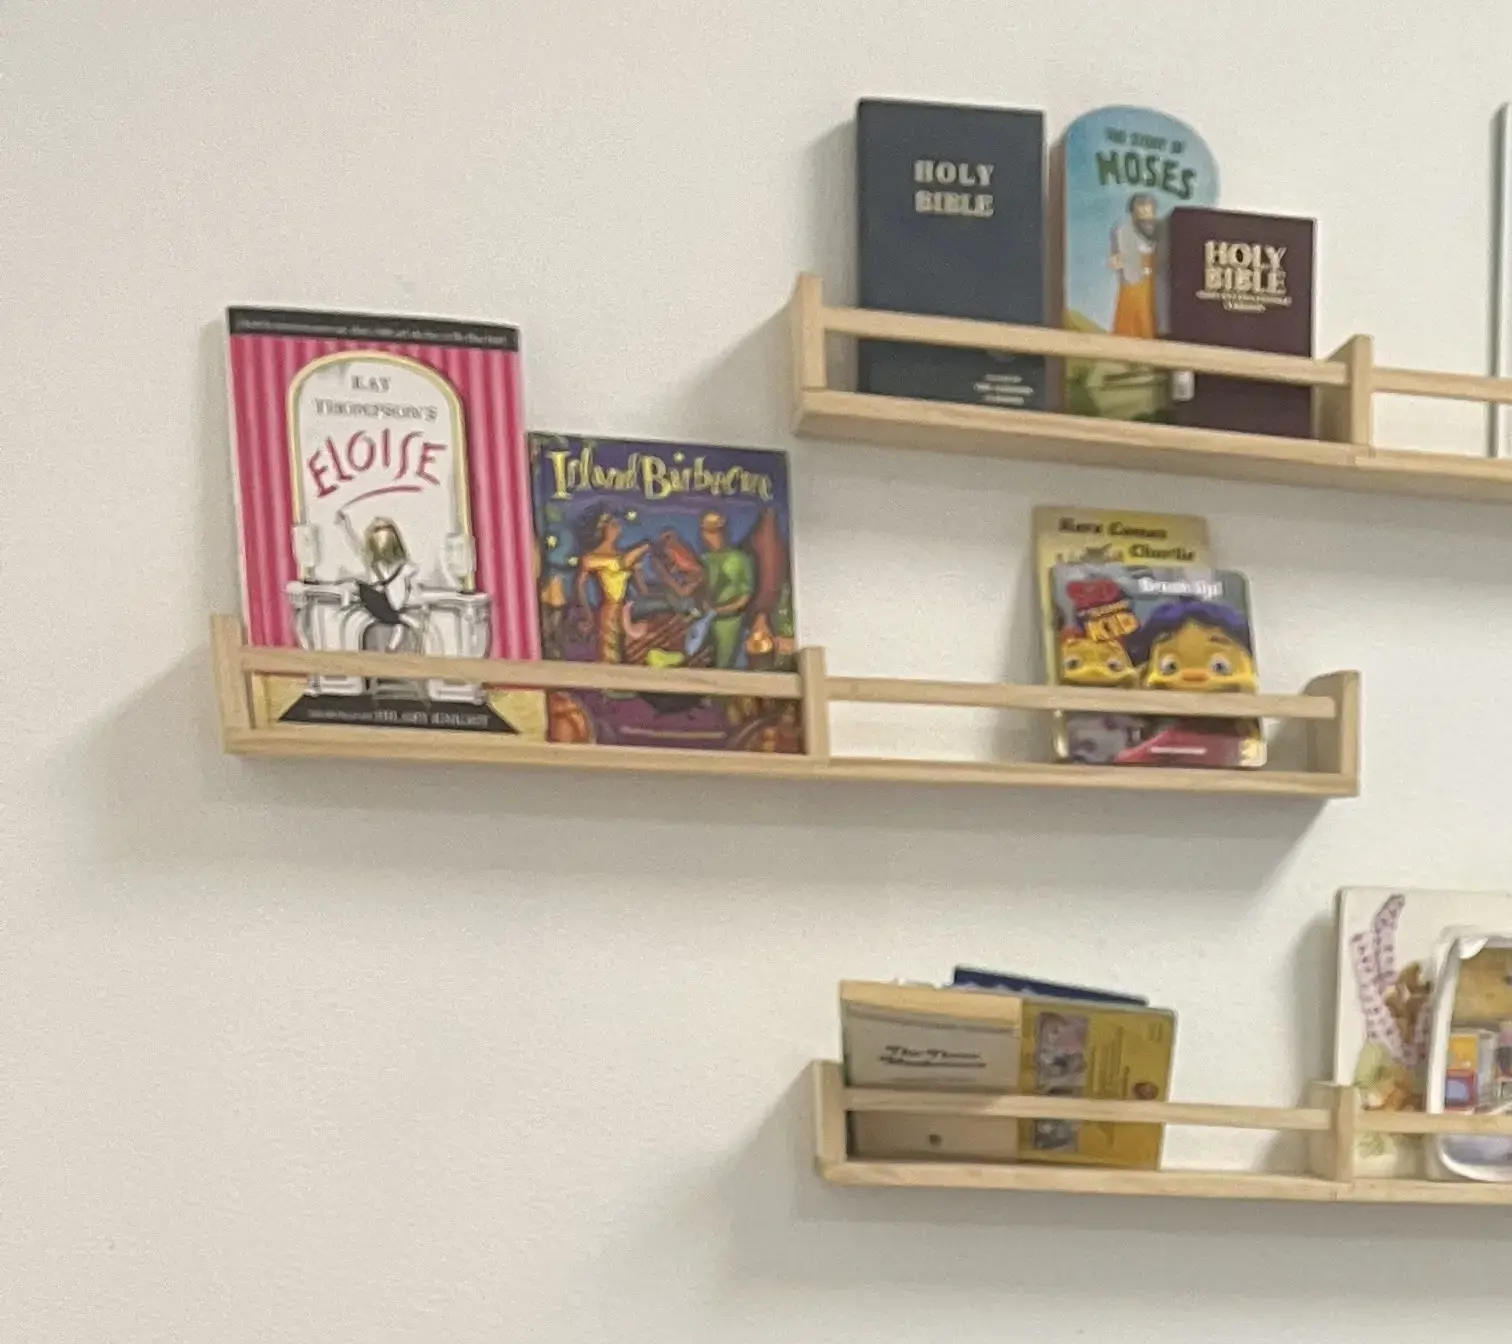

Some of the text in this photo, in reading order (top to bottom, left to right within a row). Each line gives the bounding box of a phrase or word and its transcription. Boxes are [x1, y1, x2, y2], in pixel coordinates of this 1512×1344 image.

[914, 159, 995, 187] HOLY
[1095, 150, 1197, 201] MOSES
[914, 190, 995, 218] BIBLE
[1204, 240, 1288, 268] HOLY
[1204, 266, 1287, 294] BIBLE
[351, 374, 392, 393] KAY
[307, 427, 450, 499] ELOISE
[545, 446, 641, 500] Island
